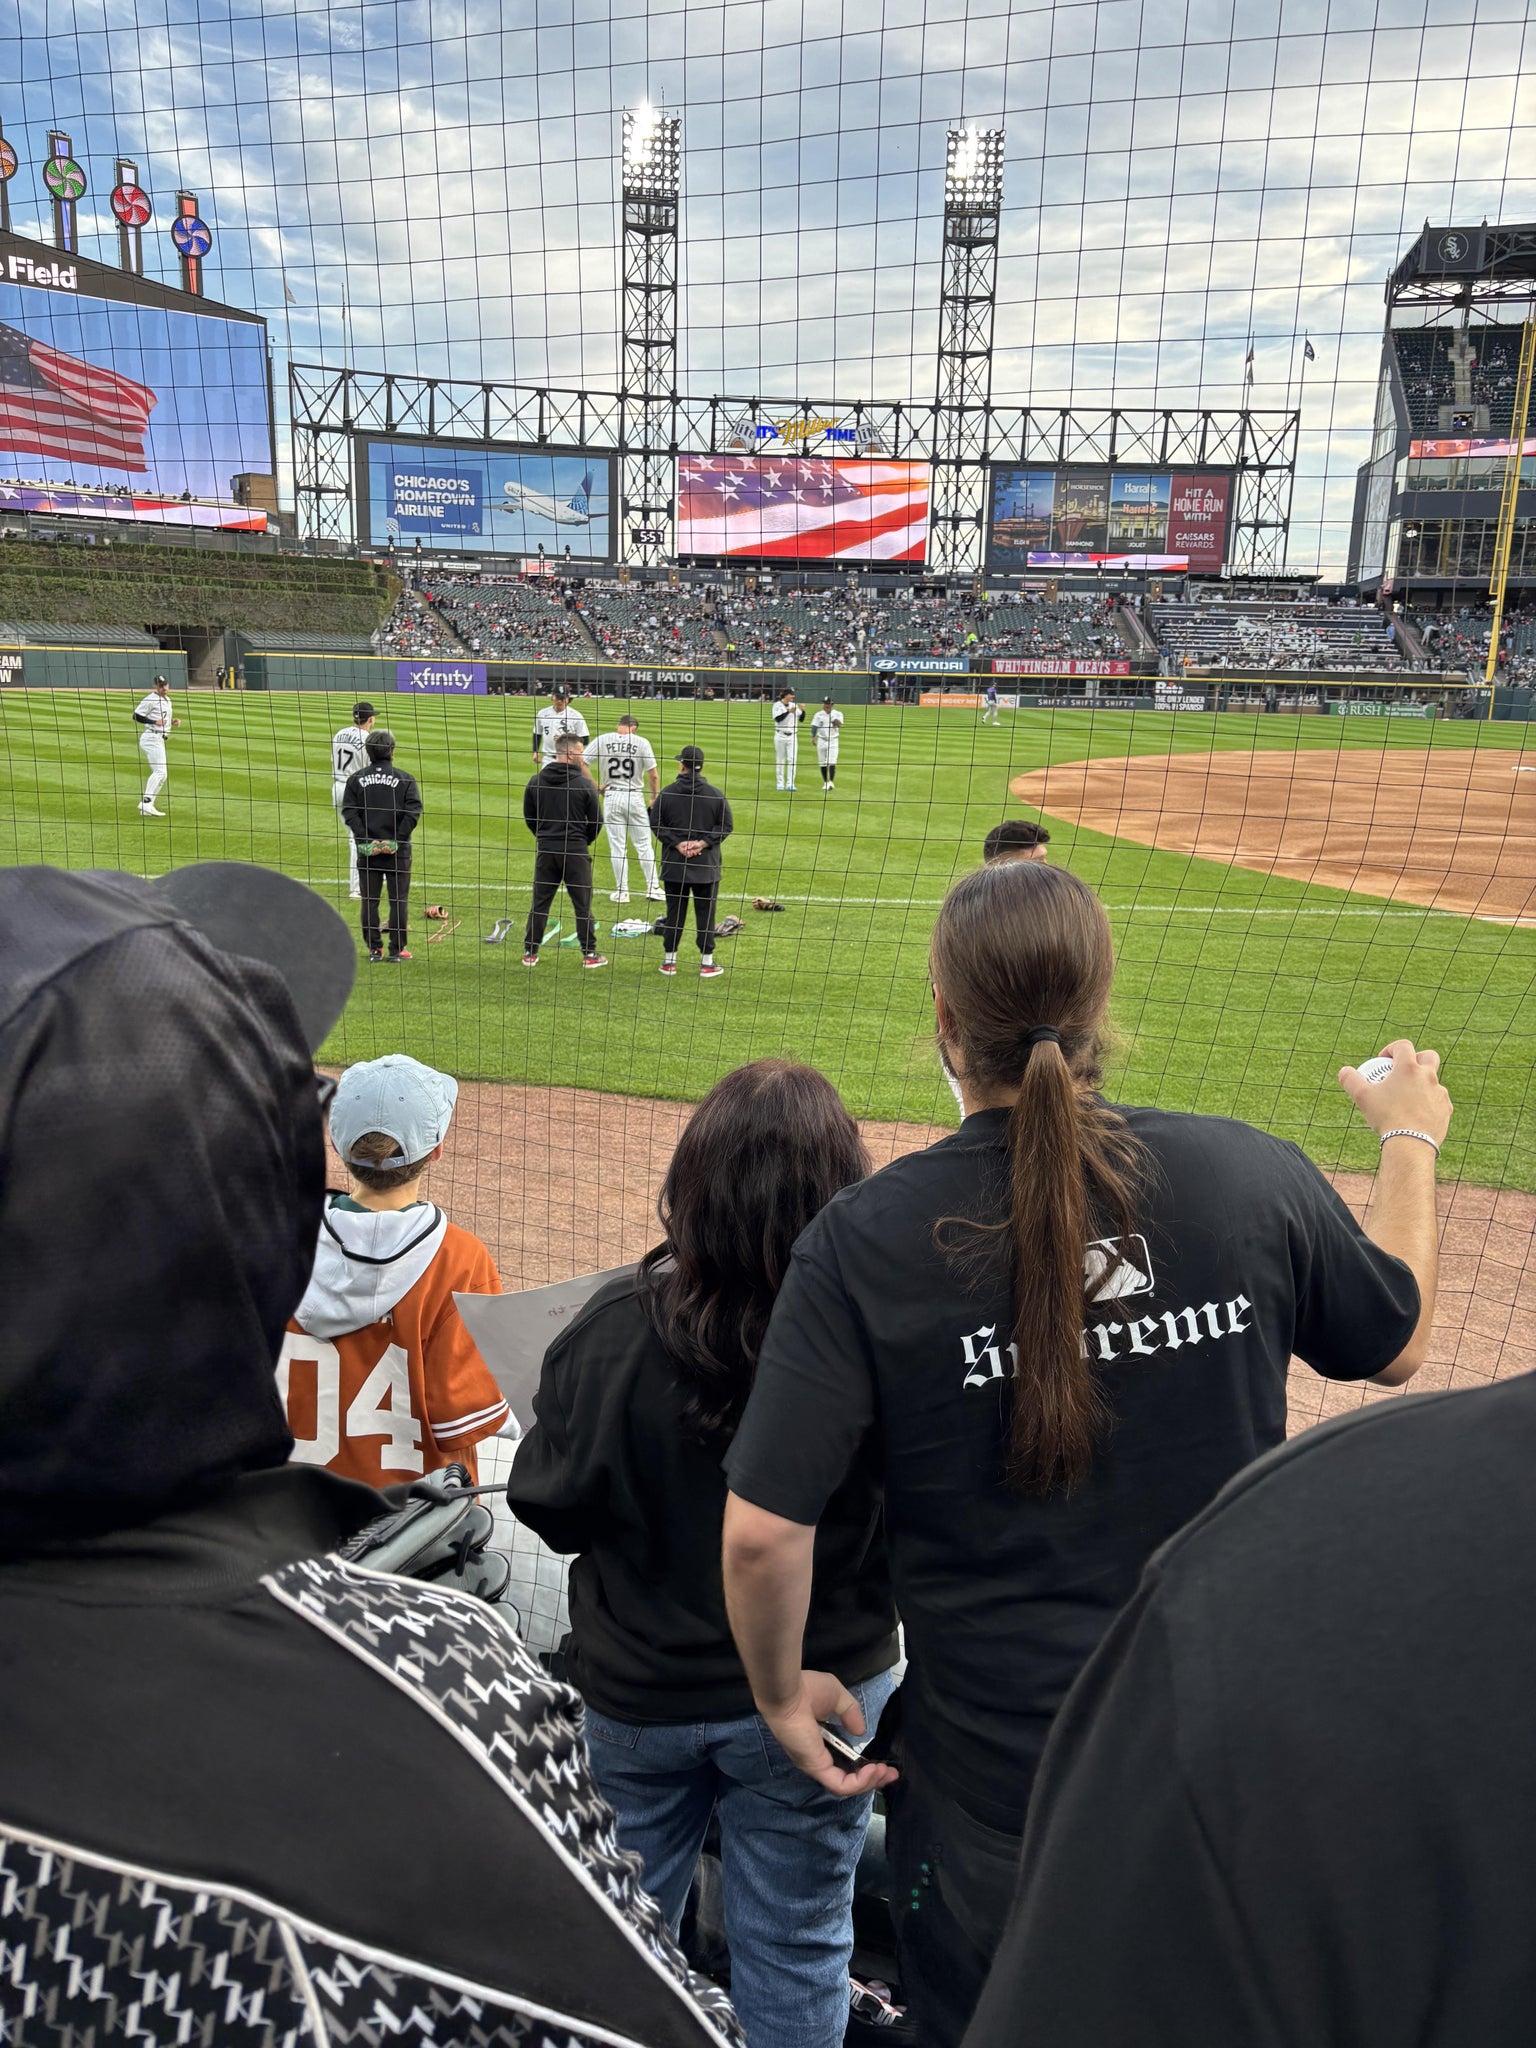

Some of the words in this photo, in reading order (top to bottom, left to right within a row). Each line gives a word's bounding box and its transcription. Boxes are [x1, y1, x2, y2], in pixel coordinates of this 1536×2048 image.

[8, 255, 78, 290] Field
[756, 425, 779, 439] IT'S
[774, 416, 840, 446] Miller
[825, 428, 856, 442] TIME
[394, 474, 470, 492] CHICAGO'S
[394, 489, 475, 506] HOMETOWN
[1185, 488, 1204, 498] HIT
[1205, 488, 1214, 498] A
[394, 503, 445, 518] AIRLINE
[1173, 498, 1200, 513] HOME
[1203, 498, 1224, 513] RUN
[1183, 512, 1212, 521] WITH
[639, 531, 664, 543] 5:57
[1175, 532, 1215, 541] CAESARS
[900, 660, 963, 671] HYUNDAI
[995, 660, 1071, 674] WHITTINGHAM
[1075, 660, 1110, 674] MEATS
[410, 667, 473, 690] xfinity
[628, 671, 653, 682] THE
[657, 671, 695, 683] PATIO
[1350, 705, 1381, 716] RUSH
[606, 742, 638, 755] PETERS
[337, 748, 354, 772] 17
[608, 757, 635, 779] 29
[359, 773, 400, 788] CHICAGO
[960, 1293, 1252, 1390] Sreme
